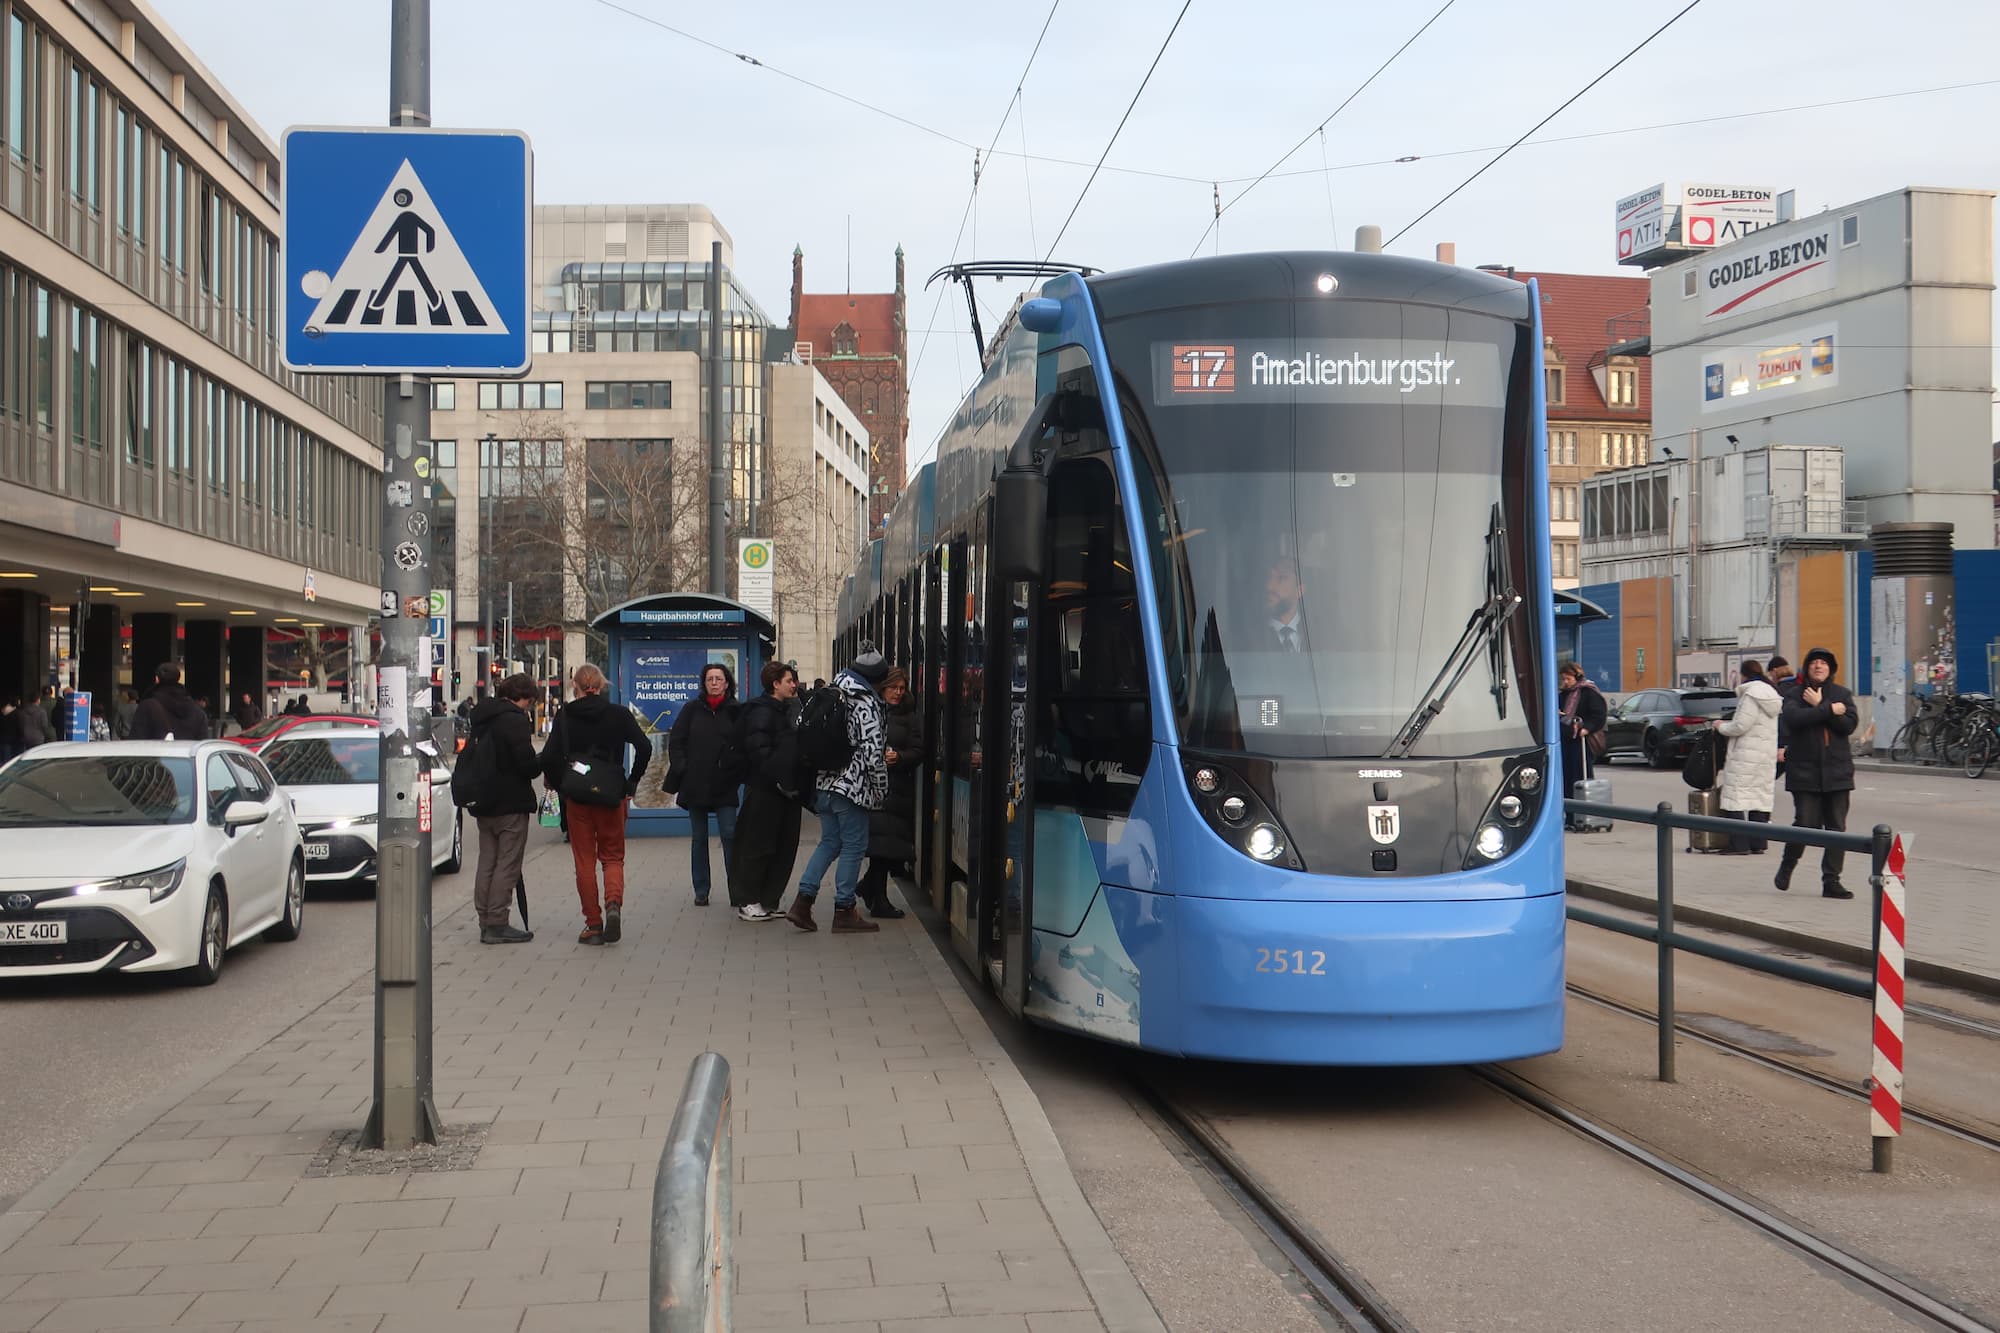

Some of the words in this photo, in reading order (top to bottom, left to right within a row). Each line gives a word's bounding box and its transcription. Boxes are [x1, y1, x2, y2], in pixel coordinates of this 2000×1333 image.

[1687, 188, 1771, 200] GODEL-BETON
[1709, 233, 1829, 289] GODEL-BETON
[1182, 351, 1226, 387] 17
[1251, 352, 1461, 392] Amalienburgstr.
[640, 612, 700, 621] Hauptbahnhof
[702, 612, 723, 620] Nord
[635, 680, 651, 690] Für
[653, 681, 673, 690] dich
[674, 681, 686, 690] ist
[687, 682, 699, 690] es
[635, 692, 689, 701] Aussteigen.
[1358, 769, 1403, 778] SIEMENS
[6, 924, 26, 939] XE
[30, 923, 59, 938] 400
[1256, 948, 1326, 976] 2512
